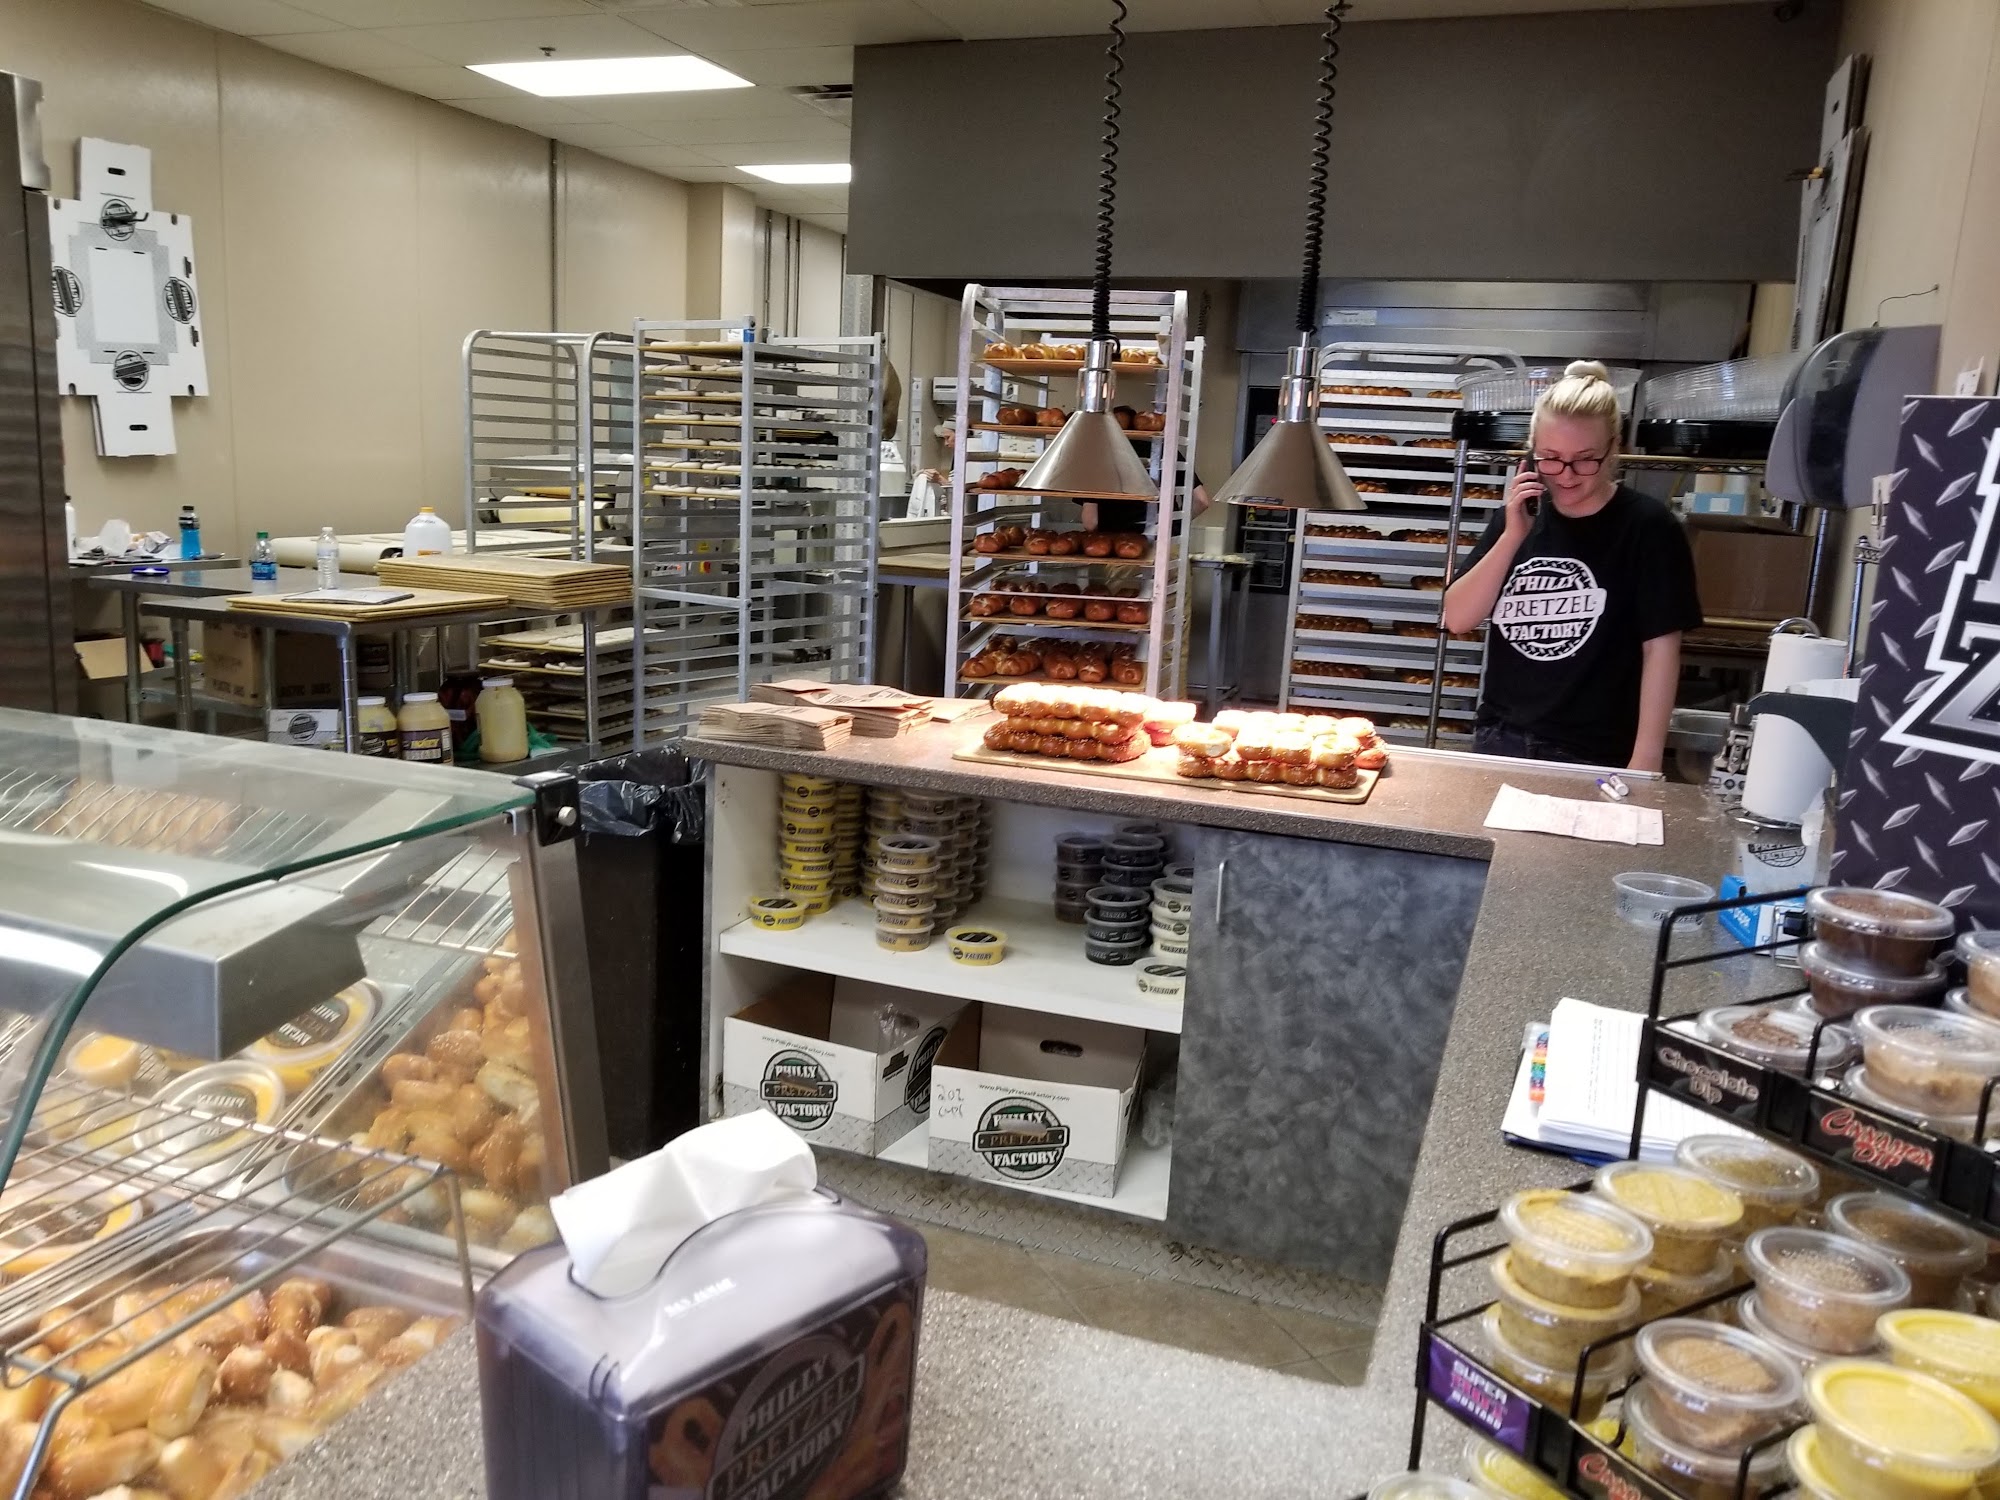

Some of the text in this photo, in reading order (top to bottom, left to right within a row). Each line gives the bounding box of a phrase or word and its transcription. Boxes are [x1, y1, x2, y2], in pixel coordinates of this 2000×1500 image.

[1512, 573, 1580, 593] PHILLY
[1501, 594, 1595, 619] PRETZEL
[1508, 621, 1586, 641] FACTORY
[774, 1065, 819, 1079] PHILLY
[1659, 1046, 1760, 1102] Chocolate
[776, 1102, 830, 1117] FACTORY
[993, 1150, 1058, 1168] FACTORY
[1453, 1359, 1508, 1406] SUPER
[732, 1352, 832, 1449] PHILLY
[1451, 1390, 1502, 1431] MUSTARD
[726, 1372, 852, 1496] PRETZEL
